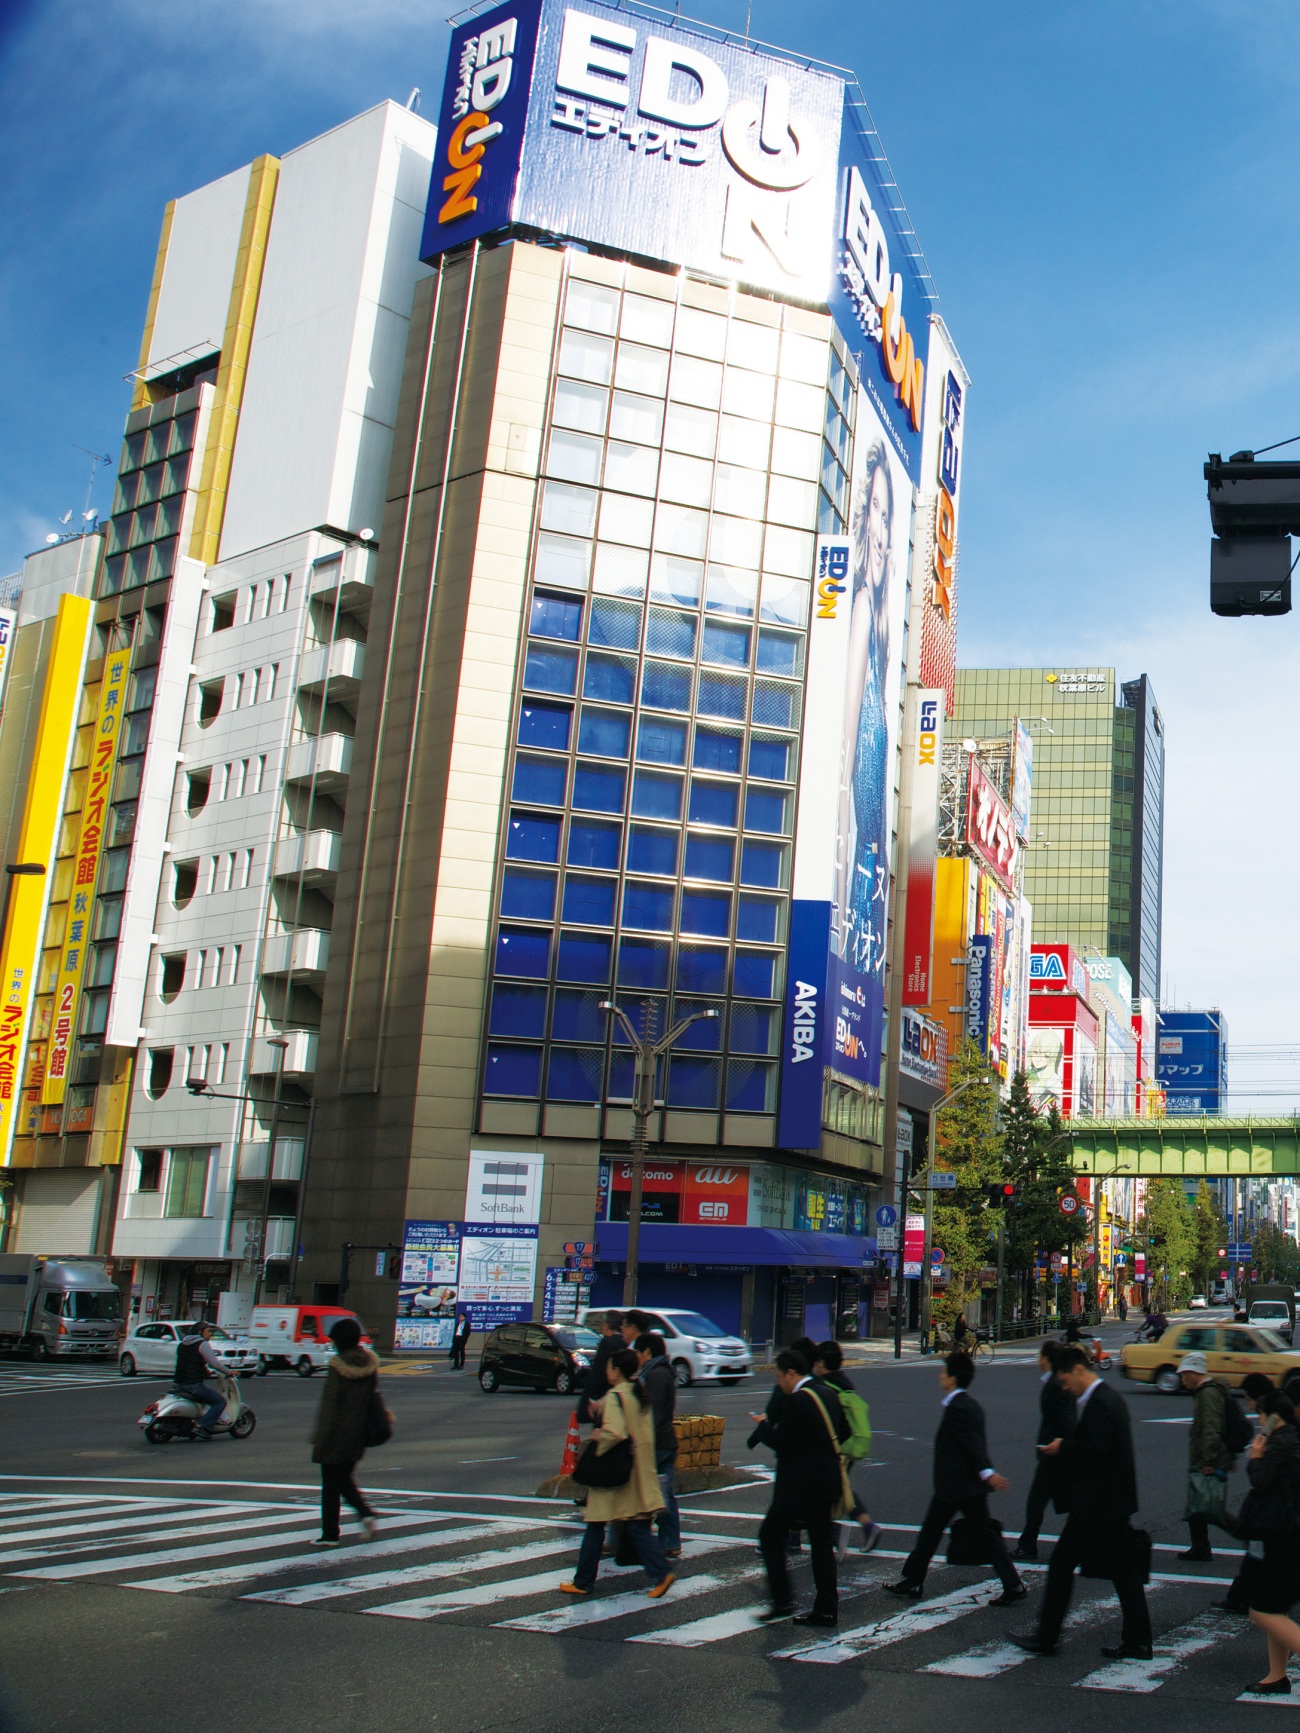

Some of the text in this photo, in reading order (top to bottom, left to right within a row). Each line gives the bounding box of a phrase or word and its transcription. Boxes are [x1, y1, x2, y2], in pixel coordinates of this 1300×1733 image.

[438, 17, 518, 225] EDION
[551, 98, 709, 166] エディオン
[844, 165, 925, 433] EDION
[817, 546, 849, 619] EDION
[1058, 683, 1106, 693] 秋葉原ビル
[1059, 673, 1106, 682] 住友不動産
[976, 783, 1018, 877] オノデン
[49, 662, 124, 1078] 世界の ラジオ会館 秋葉原 2号館
[10, 968, 25, 1004] 世界の
[914, 955, 922, 992] Electronics
[968, 946, 987, 1040] Panasonic
[792, 981, 818, 1064] AKIBA
[621, 1167, 674, 1180] domo
[695, 1167, 739, 1185] au
[481, 1203, 525, 1214] SoftBank
[699, 1202, 729, 1217] EM
[1064, 1200, 1075, 1209] 50
